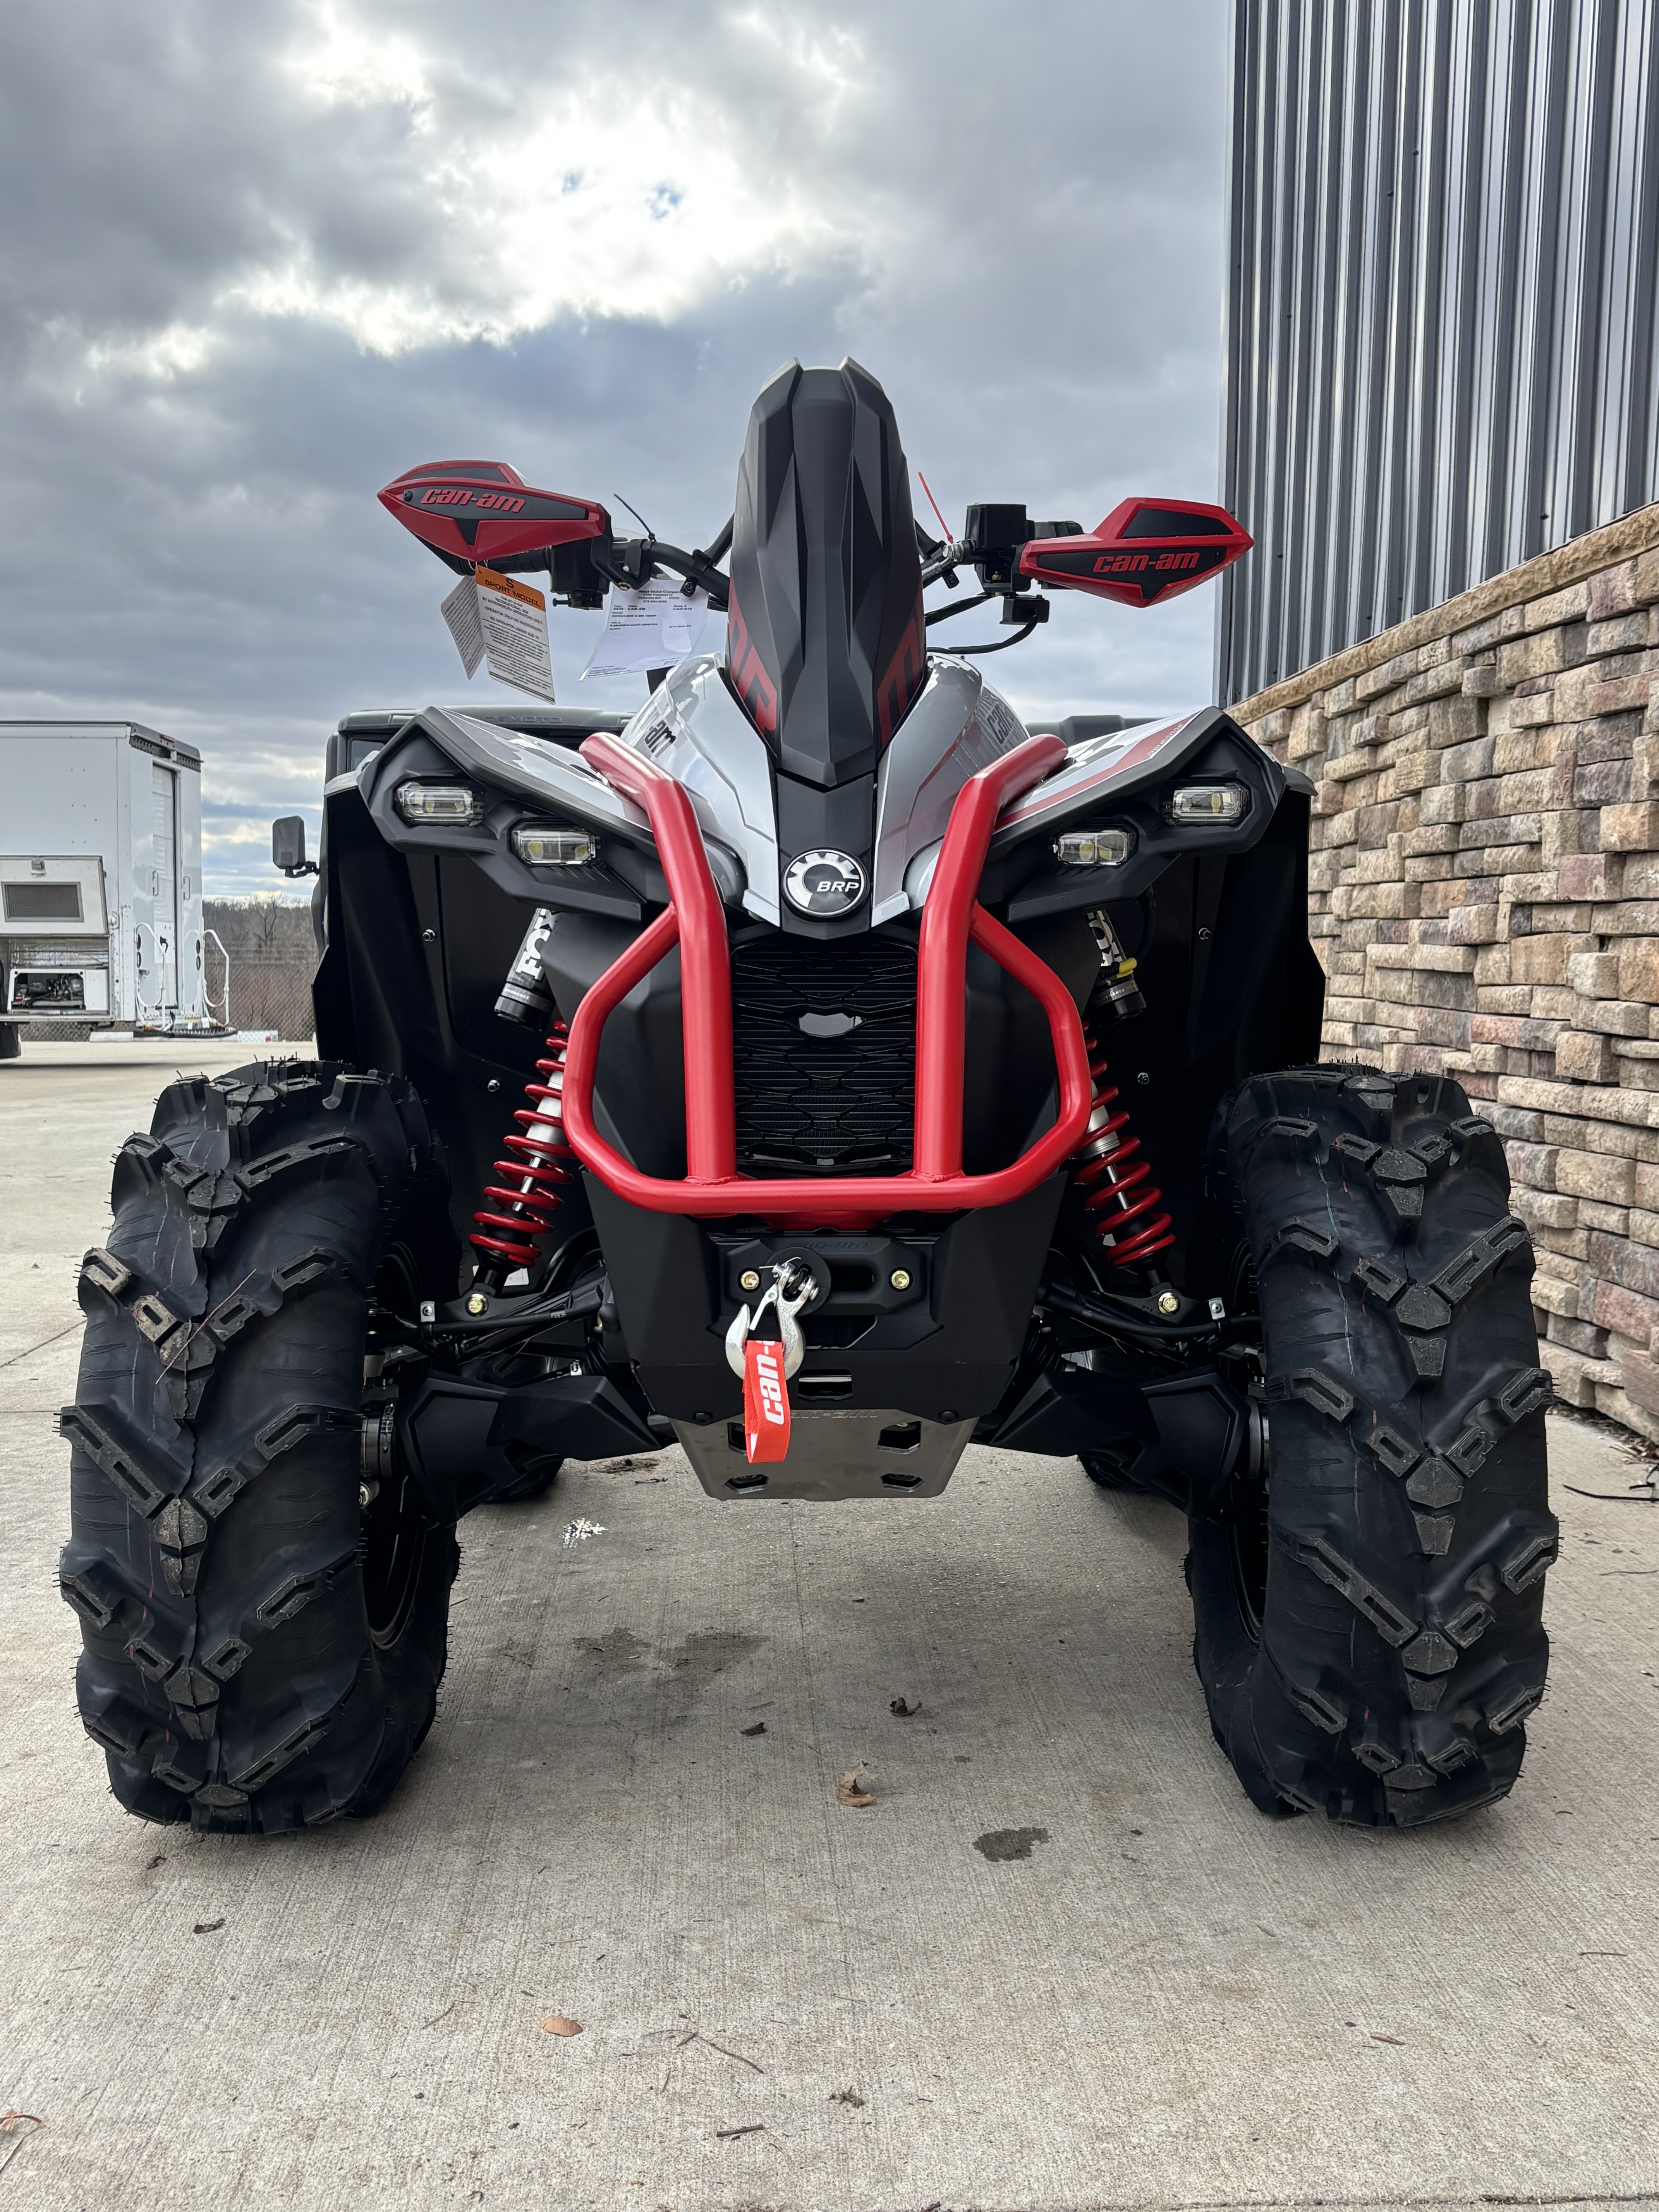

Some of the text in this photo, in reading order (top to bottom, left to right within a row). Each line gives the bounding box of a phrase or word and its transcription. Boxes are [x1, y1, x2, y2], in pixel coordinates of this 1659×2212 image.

[421, 489, 525, 512] can-am
[1093, 552, 1200, 572] can-am
[485, 579, 511, 594] SPORT
[512, 590, 540, 607] MODEL
[506, 578, 514, 589] S
[816, 881, 859, 892] BRP
[756, 1341, 785, 1425] can-
